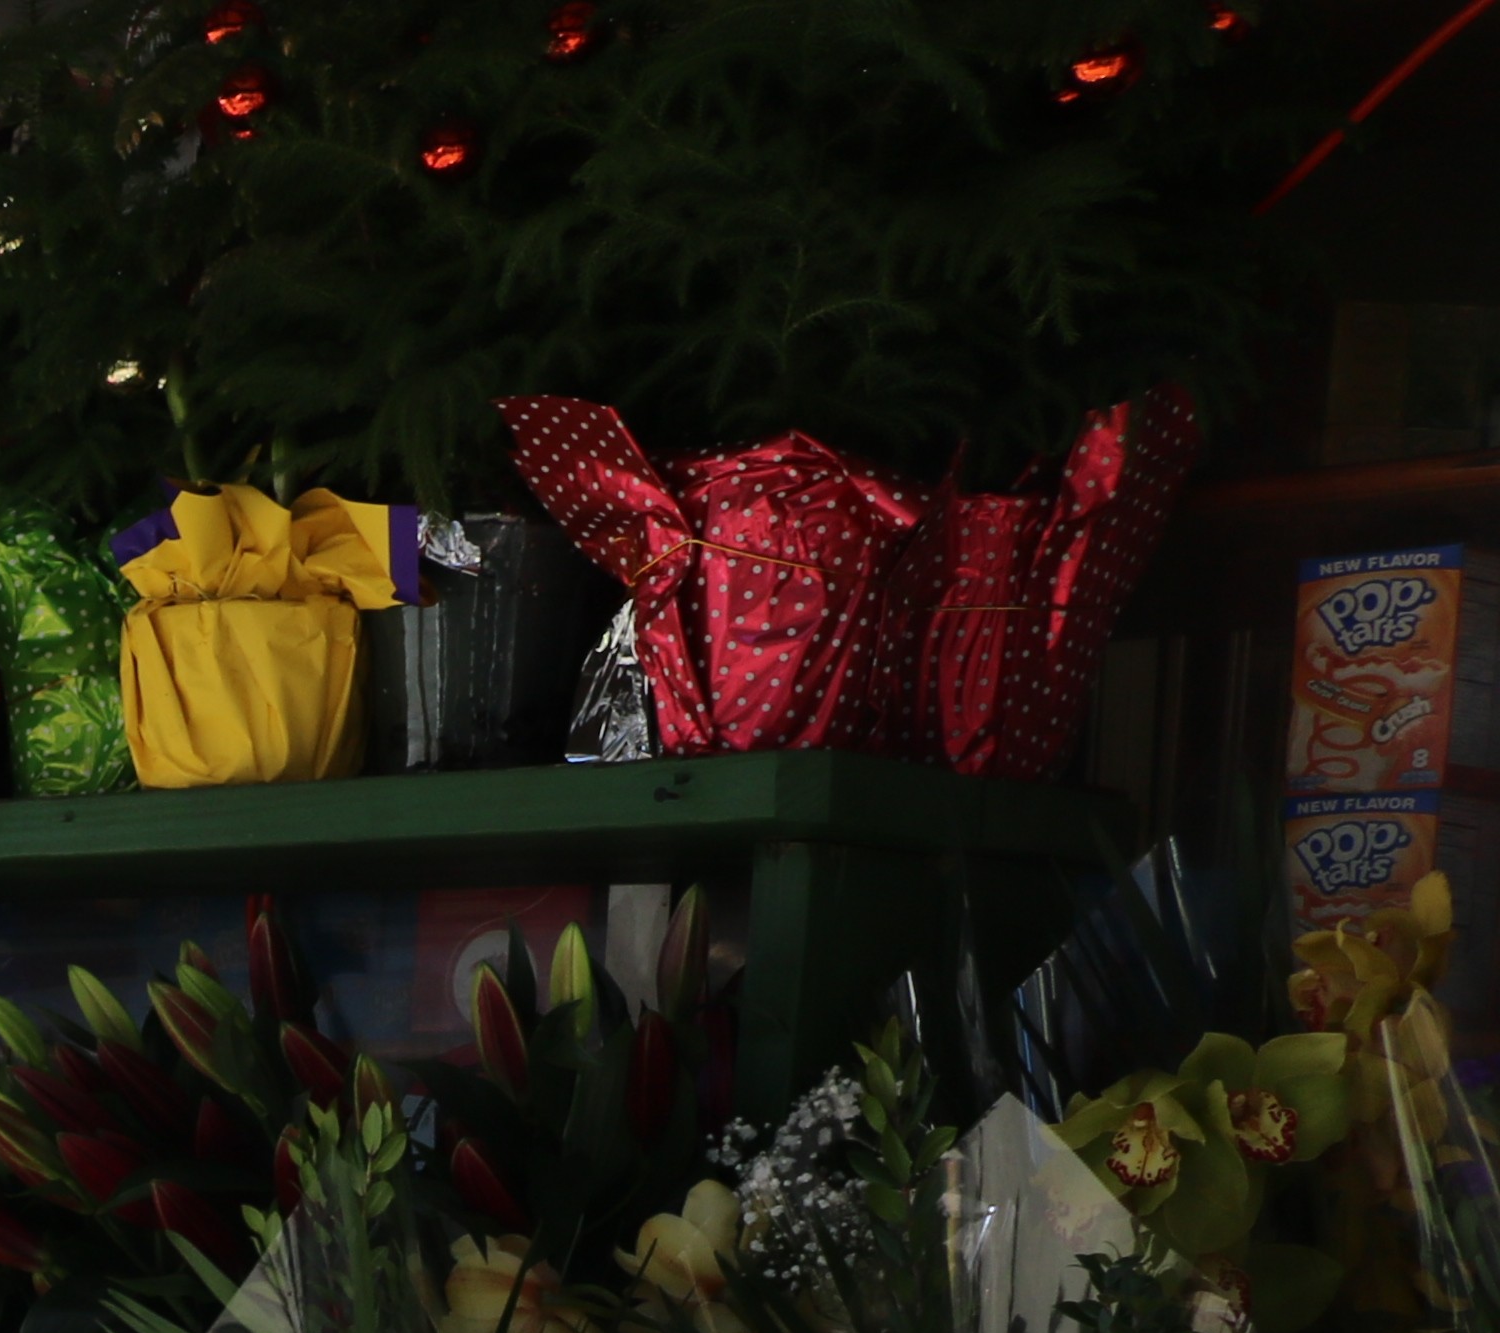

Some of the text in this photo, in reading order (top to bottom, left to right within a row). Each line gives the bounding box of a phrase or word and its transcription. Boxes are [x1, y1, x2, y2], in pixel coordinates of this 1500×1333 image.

[1319, 553, 1441, 576] NEW FLAVOR
[1371, 696, 1434, 744] Crush
[1412, 748, 1430, 769] 8
[1296, 796, 1415, 814] NEW FLAVOR
